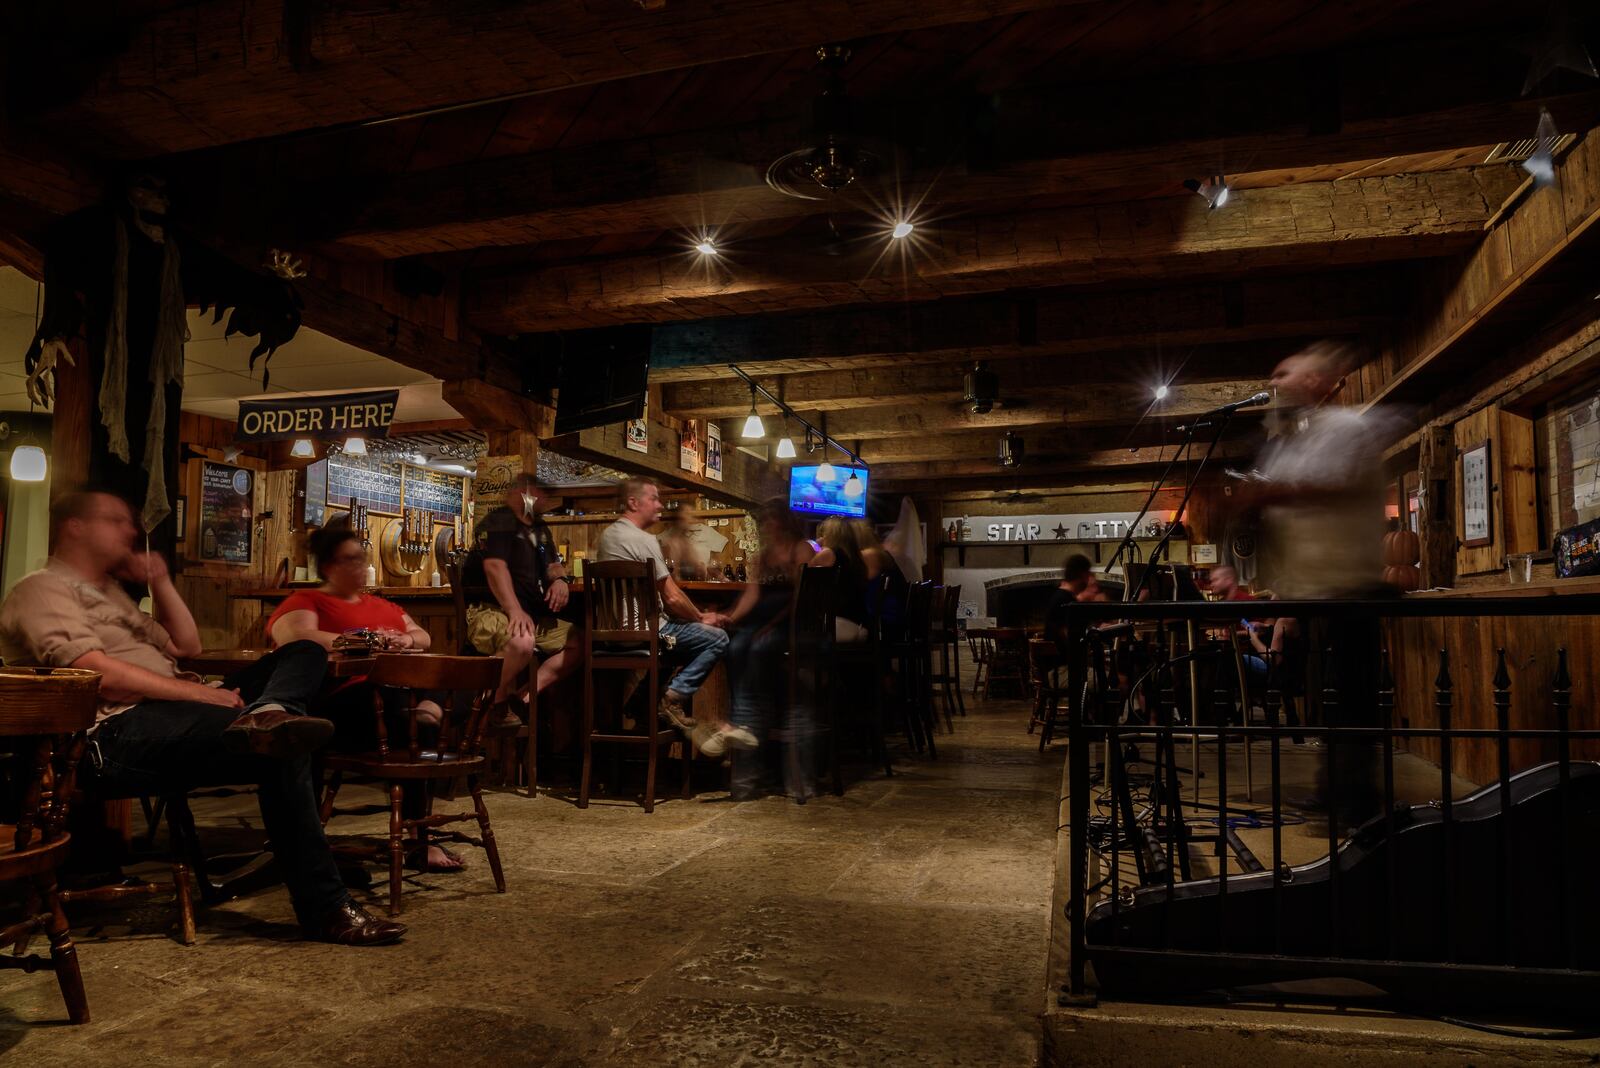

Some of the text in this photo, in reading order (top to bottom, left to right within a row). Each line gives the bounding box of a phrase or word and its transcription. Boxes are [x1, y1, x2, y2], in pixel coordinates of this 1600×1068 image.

[243, 402, 394, 434] ORDER HERE
[987, 519, 1140, 541] STAR CITY
